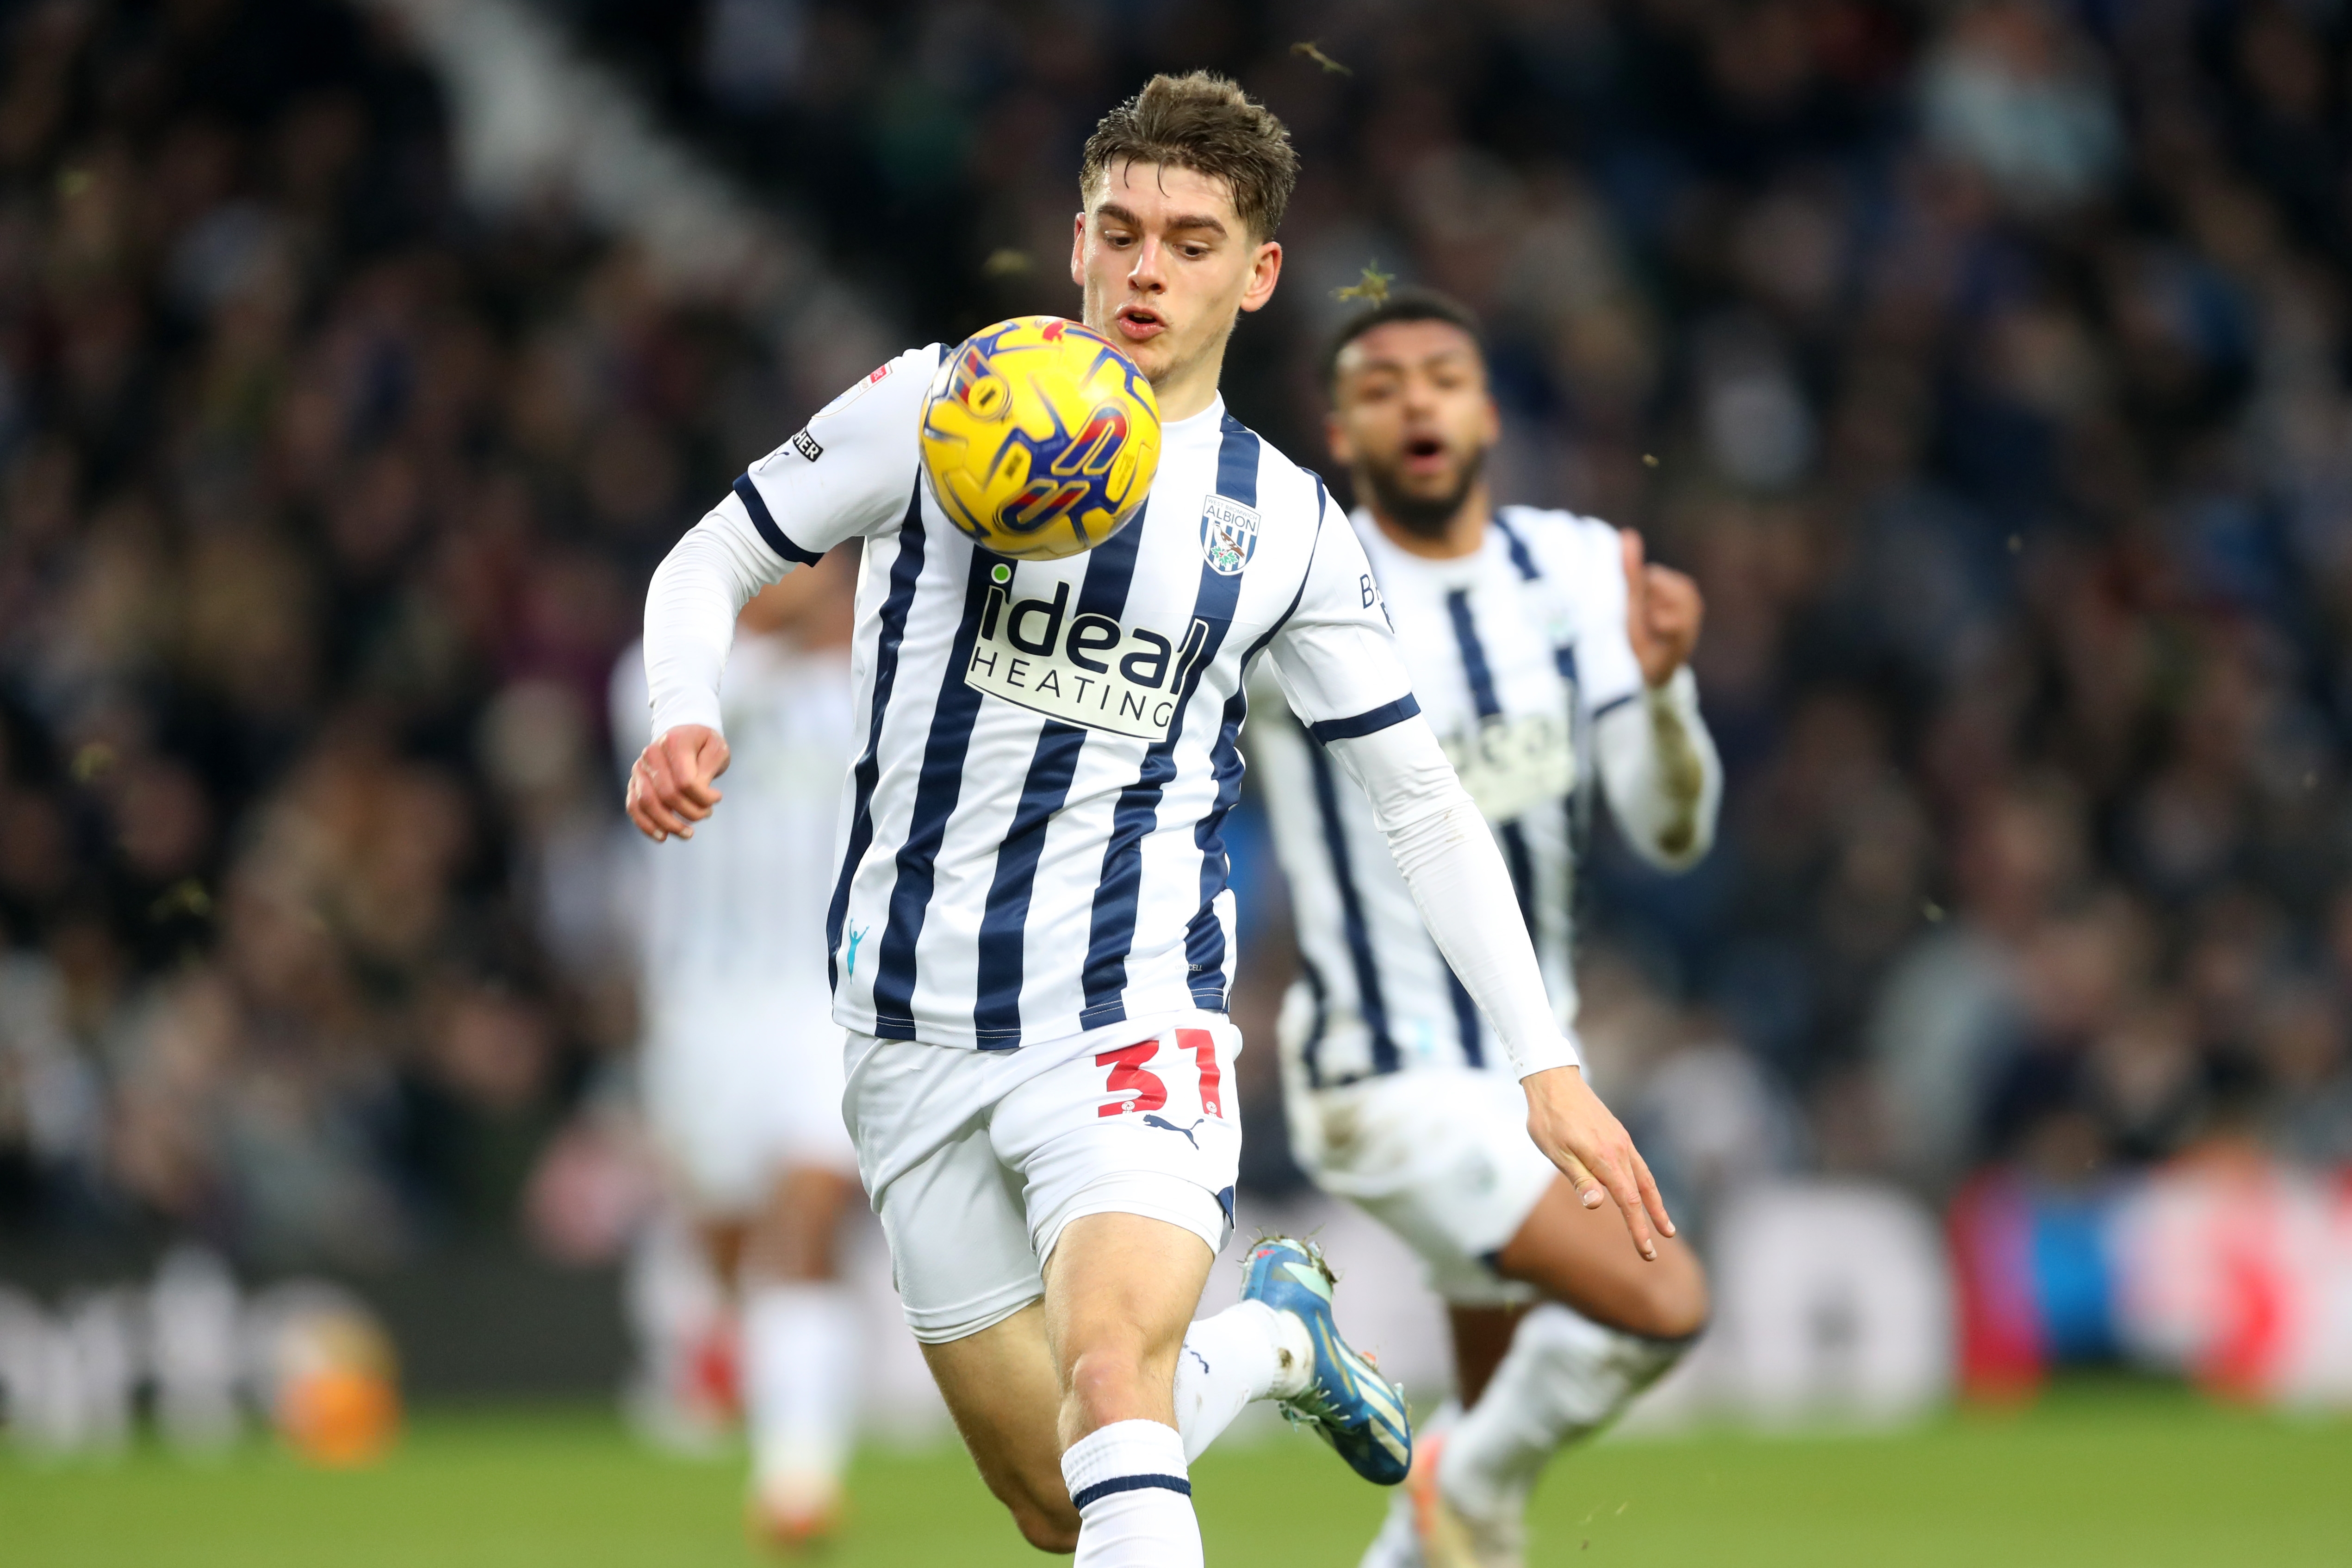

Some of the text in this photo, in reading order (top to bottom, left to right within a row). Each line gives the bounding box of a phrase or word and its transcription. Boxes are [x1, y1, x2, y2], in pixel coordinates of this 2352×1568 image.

[794, 426, 819, 459] HER
[1206, 505, 1256, 532] ALBION
[1208, 498, 1257, 521] WEST BROMWICH
[981, 566, 1206, 695] ideal
[970, 646, 1173, 727] HEATING
[1095, 1028, 1223, 1119] 31
